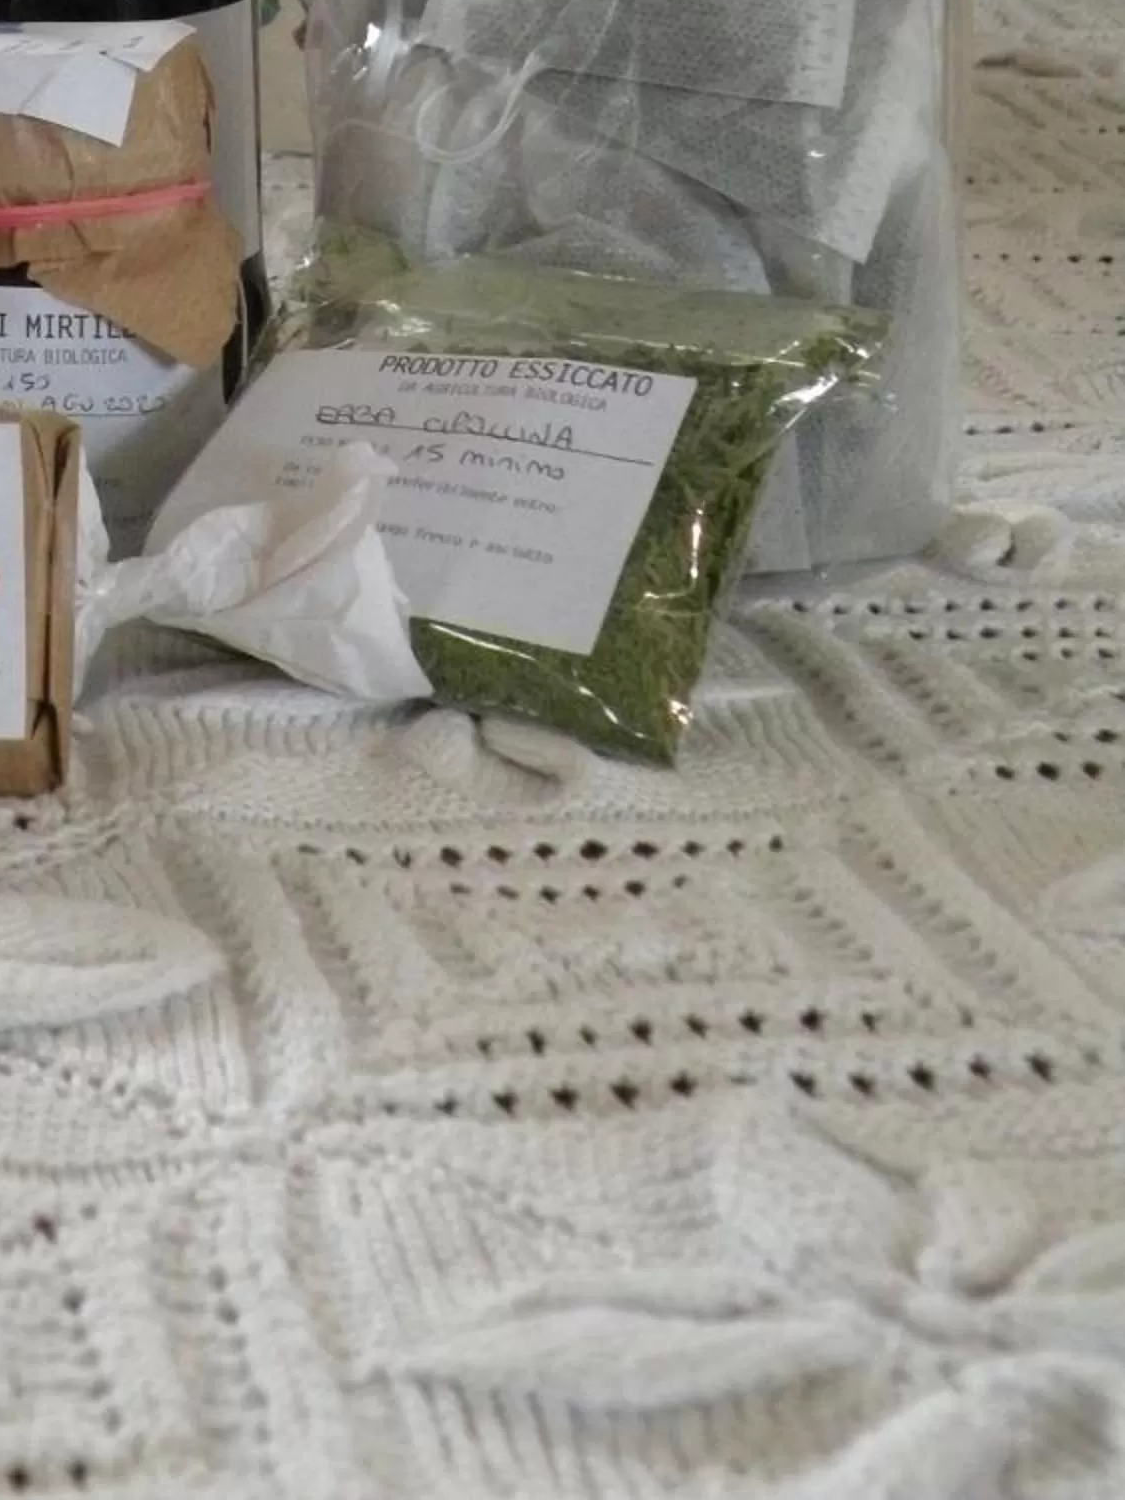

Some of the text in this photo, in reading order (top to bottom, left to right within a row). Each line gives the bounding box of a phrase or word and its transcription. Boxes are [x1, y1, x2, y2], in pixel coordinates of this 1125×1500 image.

[44, 347, 127, 365] BIOLOGICA
[379, 356, 653, 397] PRODOTTO ESSICCATO
[403, 443, 446, 463] 15
